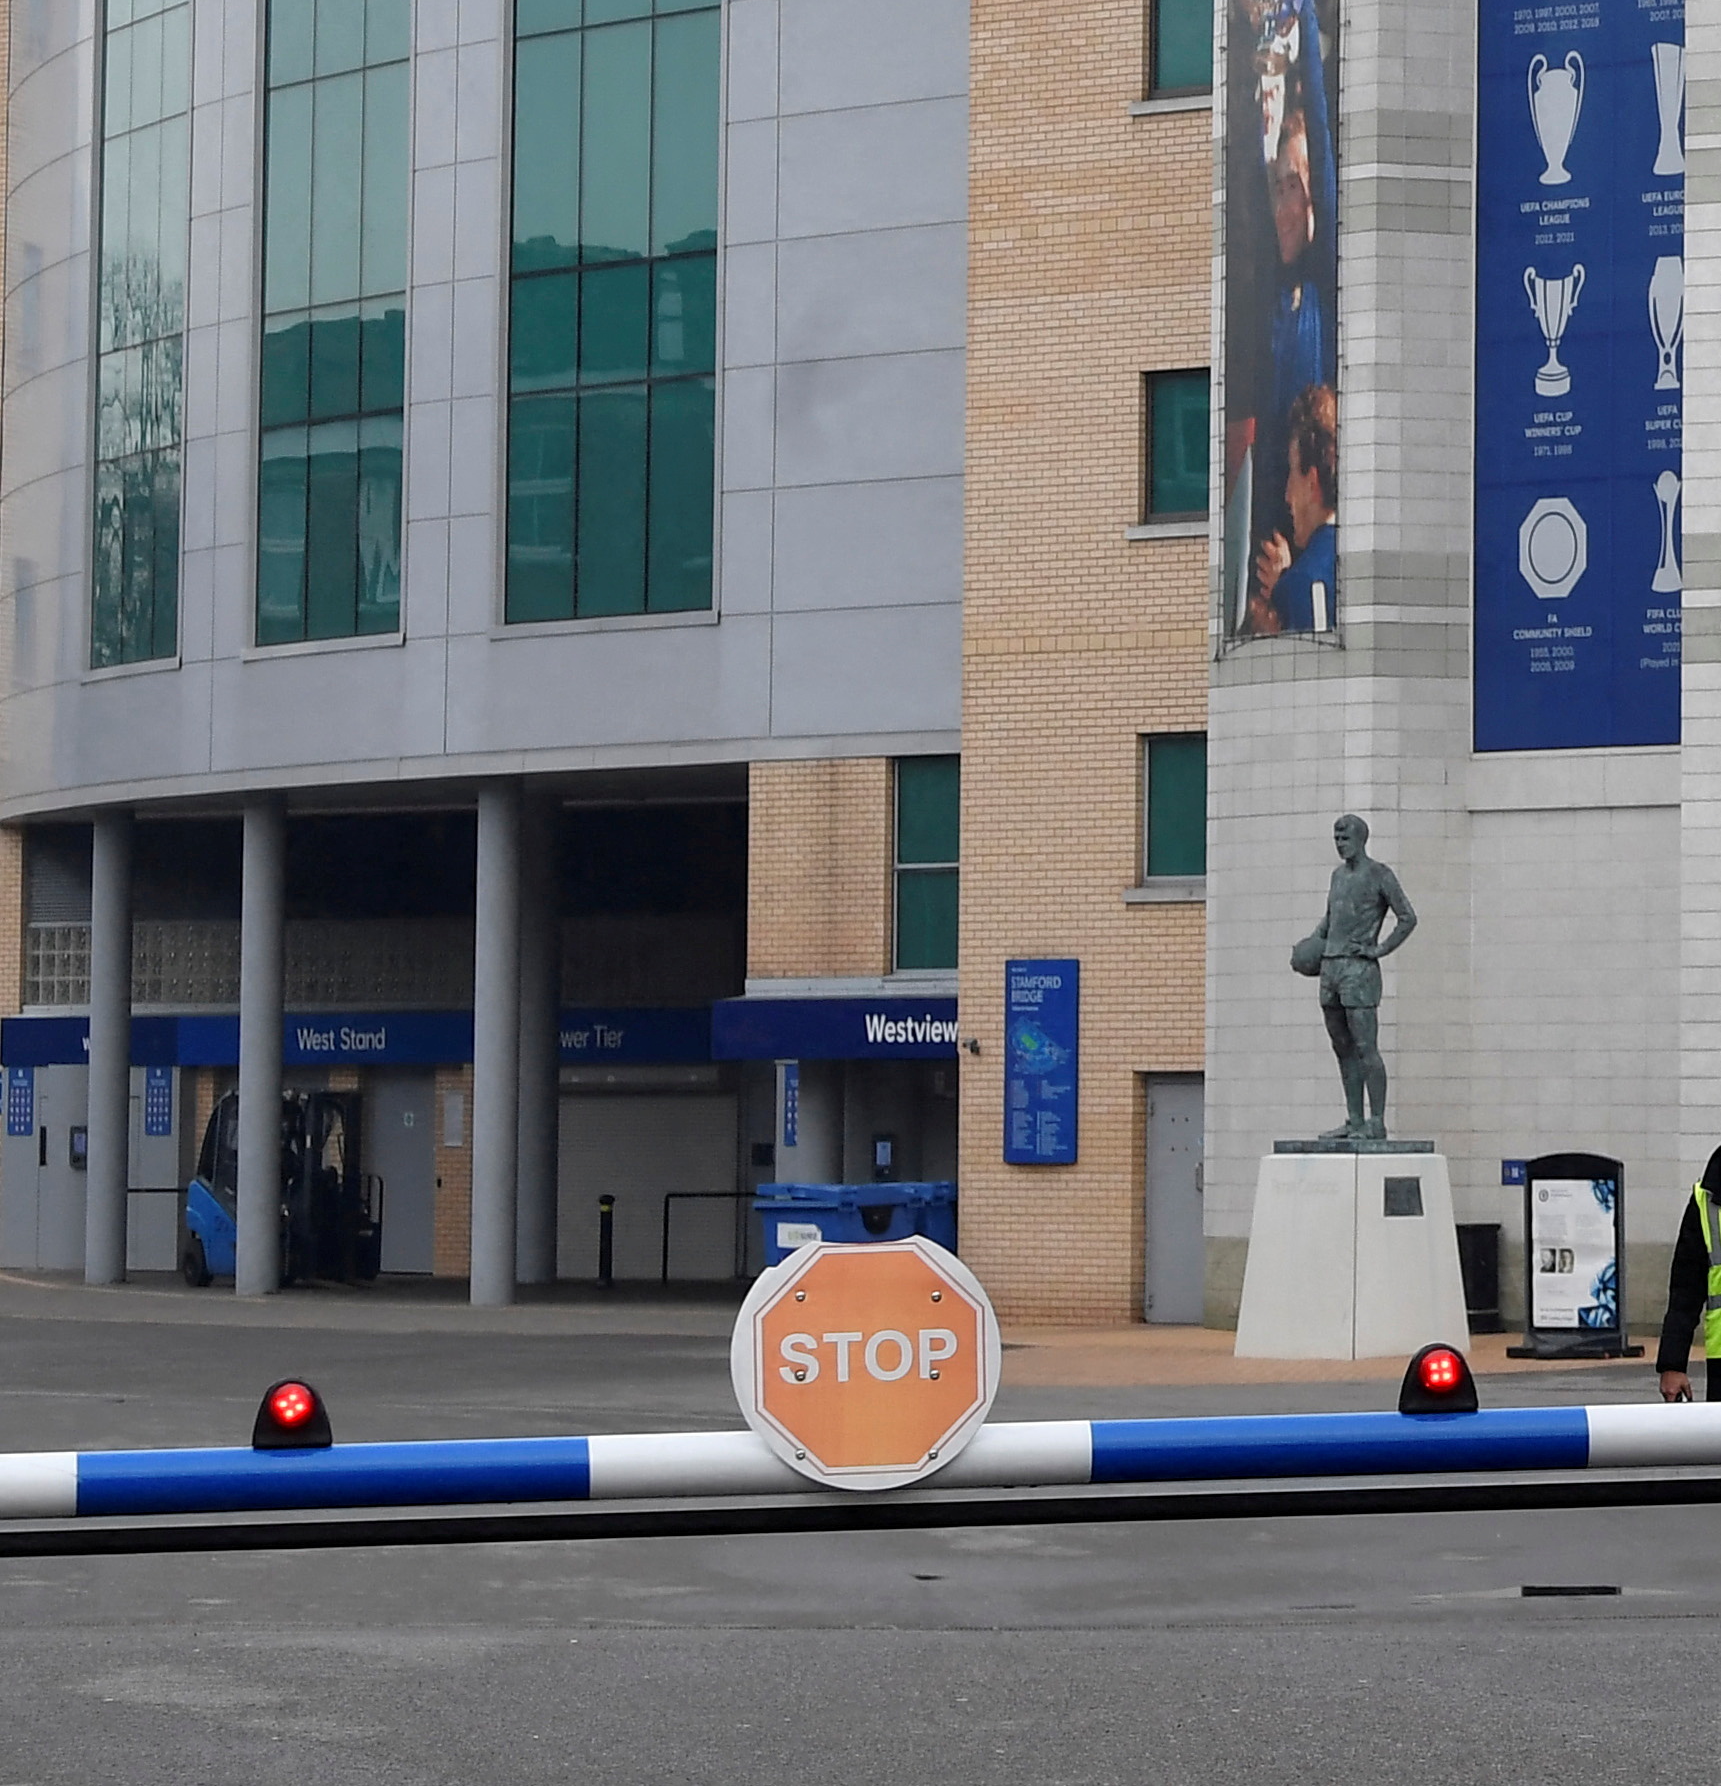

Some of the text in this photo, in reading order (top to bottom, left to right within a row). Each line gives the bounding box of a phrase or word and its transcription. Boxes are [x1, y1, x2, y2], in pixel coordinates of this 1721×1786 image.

[1641, 192, 1662, 203] UEFA
[1520, 197, 1590, 213] UEFA CHAMPIONS
[1652, 205, 1684, 217] LEAGUE
[1539, 214, 1571, 226] LEAGUE
[1657, 404, 1679, 416] UEFA
[1533, 411, 1573, 424] UEFA CUP
[1564, 425, 1583, 436] CUP
[1645, 419, 1671, 431] SUPER
[1547, 613, 1558, 624] FA
[1646, 609, 1665, 619] FIFA
[1513, 626, 1593, 640] COMMUNITY SHIELD
[1643, 623, 1682, 634] WORLD C
[1011, 975, 1062, 989] STAMFORD
[1011, 989, 1044, 1003] BRIDGE
[864, 1013, 959, 1044] Westview
[297, 1026, 386, 1051] West Stand
[593, 1025, 624, 1049] Tier
[779, 1328, 959, 1385] STOP
